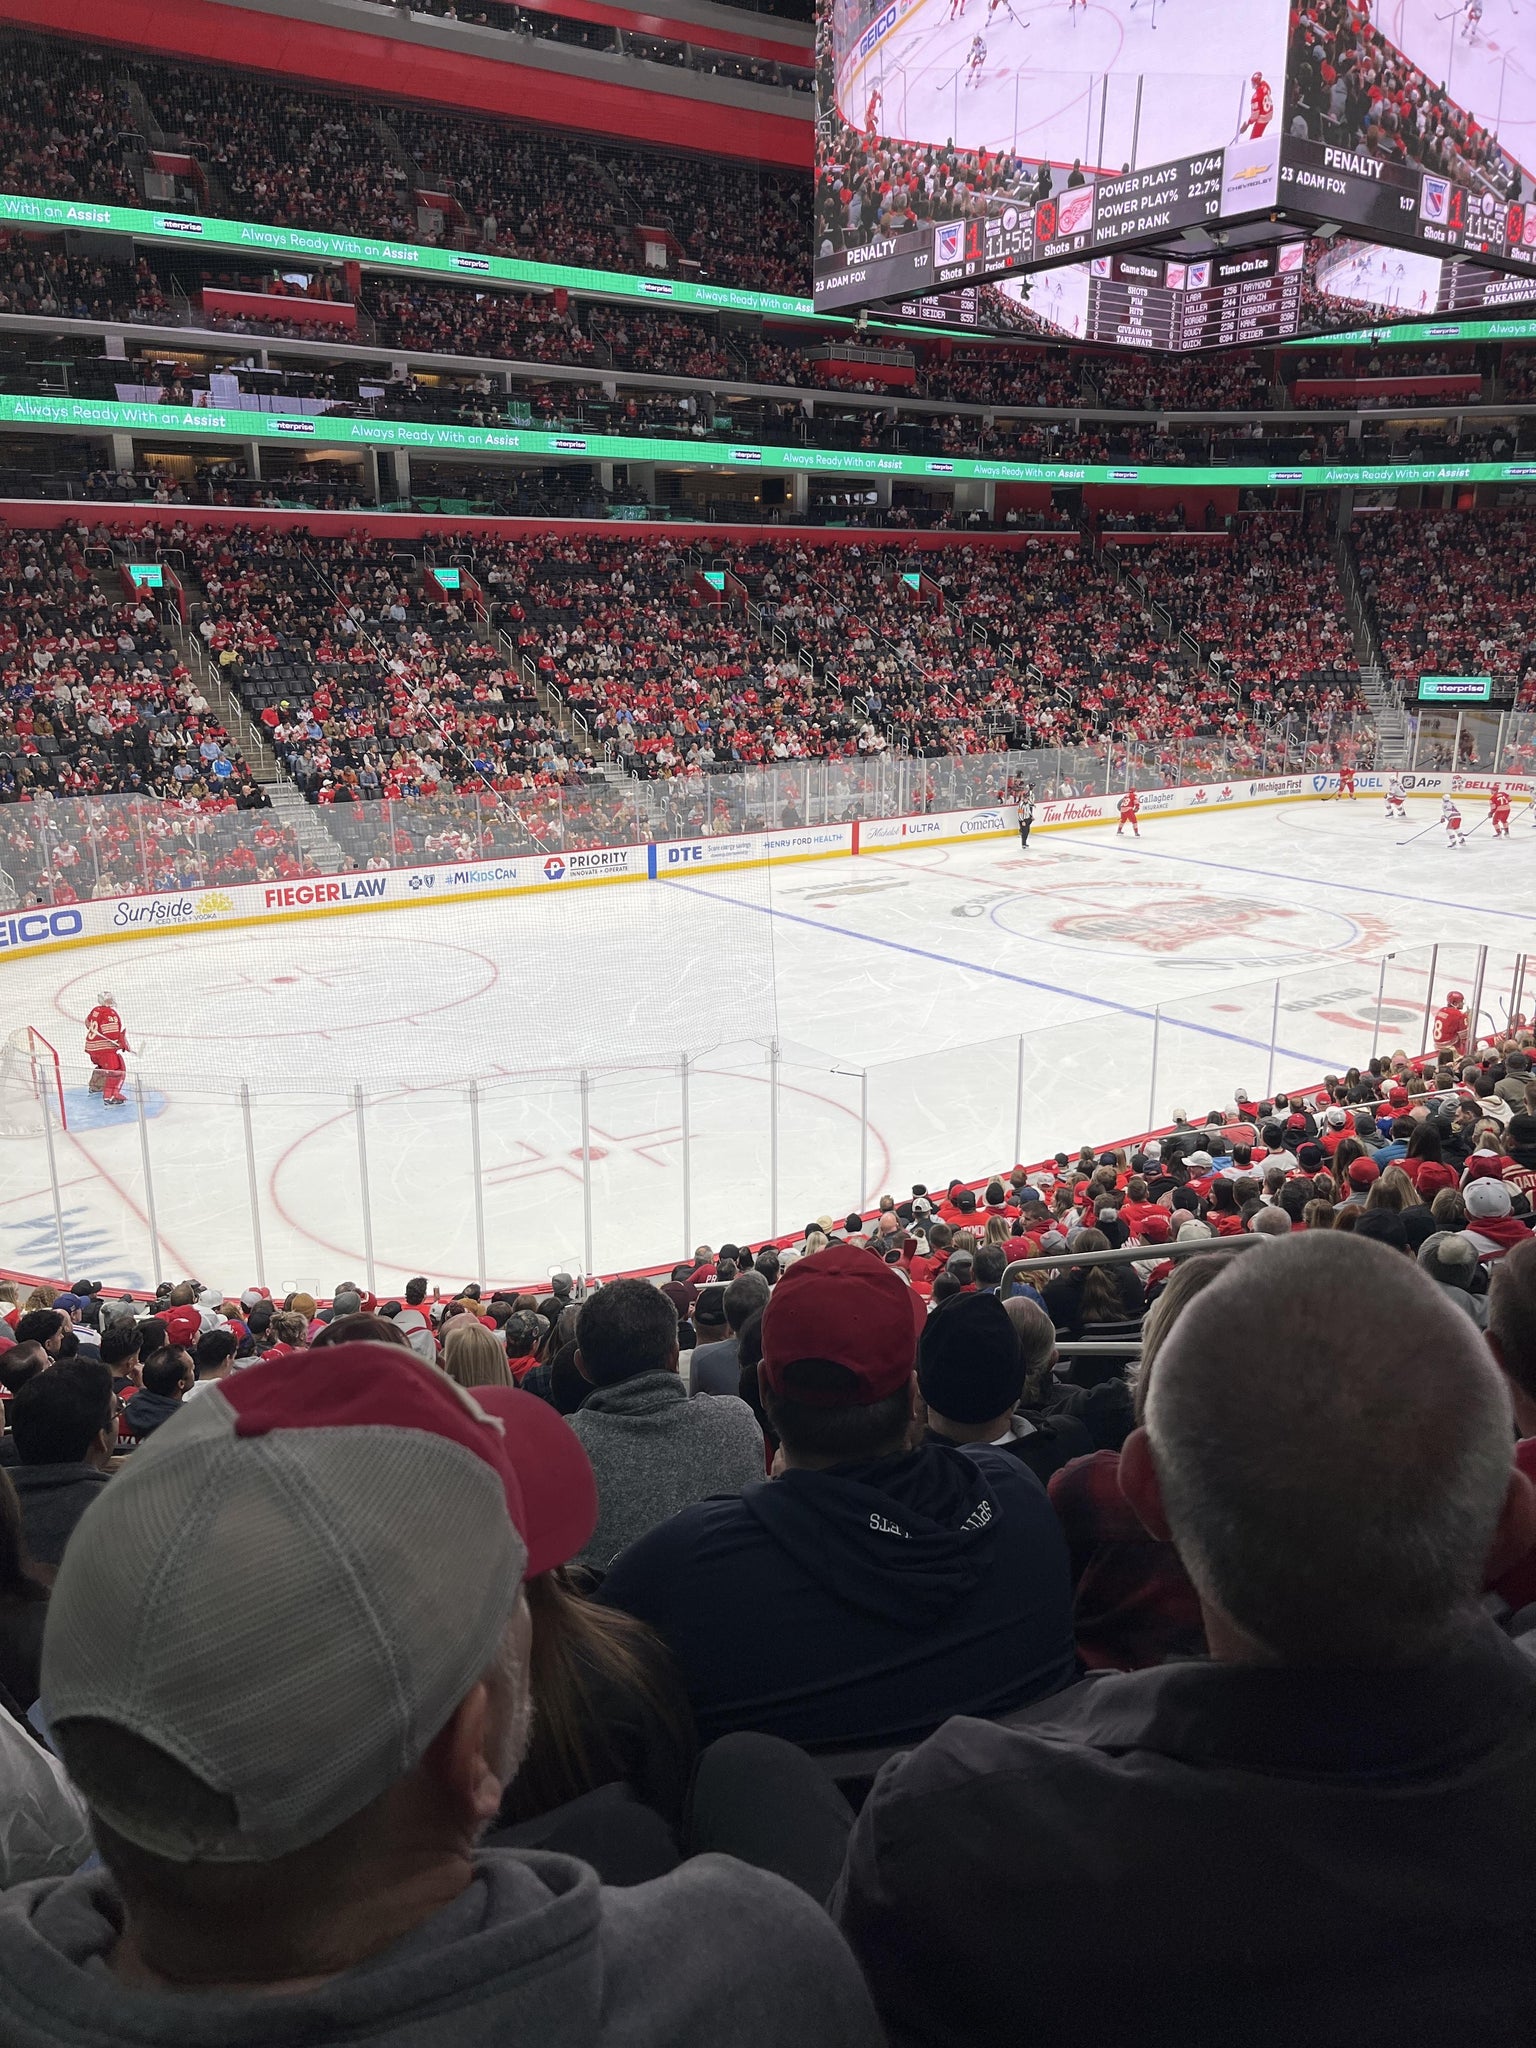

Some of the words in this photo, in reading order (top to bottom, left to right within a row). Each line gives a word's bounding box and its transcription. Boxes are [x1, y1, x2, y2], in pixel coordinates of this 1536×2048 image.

[860, 7, 896, 58] GEICO
[1324, 147, 1383, 178] PENALTY
[1099, 178, 1140, 199] POWER
[1142, 168, 1177, 188] PLAYS
[1190, 157, 1221, 176] 10/44
[1227, 178, 1272, 192] CHEVROLET
[1281, 167, 1293, 181] 23
[1296, 171, 1324, 190] ADAM
[1327, 178, 1346, 194] FOX
[1098, 202, 1138, 220] POWER
[1140, 189, 1178, 210] PLAY%
[1188, 179, 1219, 198] 22.7%
[1400, 197, 1414, 211] 1:17
[6, 201, 40, 215] With
[44, 207, 62, 218] an
[67, 207, 110, 223] Assist
[1449, 190, 1463, 229] 1
[155, 218, 202, 232] enterprise
[1037, 204, 1055, 241] 0
[1097, 226, 1118, 241] NHL
[1121, 219, 1135, 234] PP
[1138, 212, 1170, 230] RANK
[1205, 201, 1217, 214] 10
[1424, 226, 1445, 241] Shots
[1466, 215, 1504, 244] 11:56
[241, 227, 286, 245] Always
[291, 233, 329, 253] Ready
[332, 239, 361, 253] With
[365, 245, 380, 255] an
[382, 246, 419, 261] Assist
[966, 223, 982, 259] 1
[985, 229, 1032, 259] 11:56
[1464, 240, 1481, 251] Period
[847, 239, 896, 266] PENALTY
[1045, 242, 1069, 256] Shots
[1511, 248, 1530, 260] Shots
[452, 256, 489, 269] enterprise
[914, 255, 928, 267] 1:17
[985, 260, 1005, 272] Period
[1220, 265, 1240, 275] Time
[1242, 262, 1254, 271] On
[1255, 259, 1268, 268] Ice
[941, 268, 962, 281] Shots
[1121, 263, 1139, 275] Game
[1141, 266, 1157, 277] Stats
[639, 282, 672, 293] enterprise
[816, 282, 824, 292] 23
[827, 276, 849, 289] ADAM
[850, 271, 865, 282] FOX
[1243, 280, 1271, 292] RAYMOND
[1485, 279, 1536, 293] GIVEAWAY
[1128, 287, 1147, 296] SHOTS
[1242, 293, 1266, 304] LARKIN
[1483, 290, 1536, 305] TAKEAWAY
[696, 288, 727, 302] Always
[730, 292, 757, 306] Ready
[760, 297, 779, 309] With
[782, 302, 793, 310] an
[923, 309, 945, 319] SEIDER
[1129, 307, 1143, 315] HITS
[1185, 303, 1208, 314] MILLER
[1241, 303, 1276, 316] DEBRINCAT
[1118, 325, 1152, 336] GIVEAWAYS
[1240, 329, 1263, 339] SEIDER
[1489, 324, 1525, 336] Always
[1116, 335, 1152, 346] TAKEAWAYS
[15, 402, 68, 421] Always
[73, 405, 119, 426] Ready
[122, 409, 158, 423] With
[162, 413, 179, 424] an
[183, 414, 226, 428] Assist
[268, 420, 314, 432] enterprise
[352, 424, 394, 441] Always
[398, 429, 434, 445] Ready
[437, 431, 463, 443] With
[467, 435, 481, 444] an
[485, 434, 519, 446] Assist
[550, 439, 585, 449] enterprise
[730, 450, 761, 460] enterprise
[783, 453, 814, 466] Always
[817, 456, 842, 468] Ready
[844, 457, 862, 467] With
[866, 459, 876, 467] an
[878, 459, 902, 469] Assist
[927, 463, 953, 472] enterprise
[974, 465, 1000, 477] Always
[1002, 467, 1023, 479] Ready
[1025, 468, 1042, 477] With
[1058, 468, 1084, 479] Assist
[1108, 471, 1137, 479] enterprise
[1270, 472, 1302, 480] enterprise
[1326, 471, 1359, 482] Always
[1362, 470, 1393, 482] Ready
[1396, 469, 1419, 478] With
[1423, 469, 1435, 477] an
[1438, 468, 1470, 478] Assist
[1427, 684, 1484, 693] enterprise
[1258, 783, 1286, 792] Michigan
[1329, 778, 1382, 787] FADUEL
[1465, 781, 1499, 789] BELLE
[1139, 793, 1174, 803] Gallagher
[1043, 806, 1061, 822] Tim
[1062, 803, 1102, 820] Hortons
[909, 822, 940, 833] ULTRA
[960, 817, 1005, 834] Comerica
[763, 837, 790, 849] HENRY
[793, 836, 812, 846] FORD
[814, 834, 843, 843] HEALTH
[570, 852, 627, 867] PRIORITY
[669, 846, 702, 863] DTE
[265, 878, 387, 908] FIEGERLAW
[114, 898, 193, 926] Surfside
